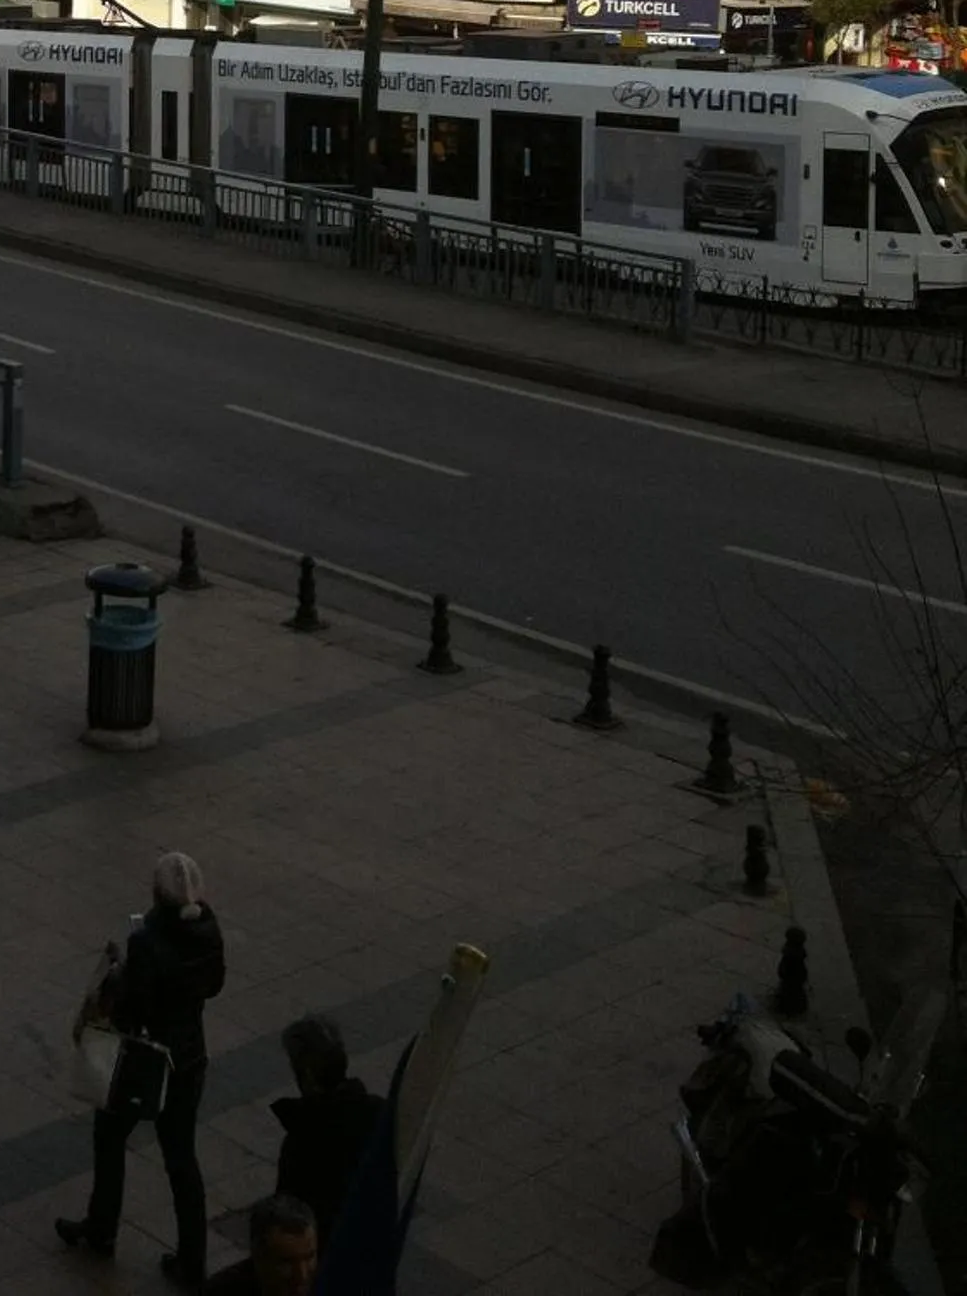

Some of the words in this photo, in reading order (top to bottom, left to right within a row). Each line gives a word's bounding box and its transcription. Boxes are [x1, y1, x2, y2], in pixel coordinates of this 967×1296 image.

[604, 0, 680, 16] TURKCELL
[49, 44, 123, 65] HYUNDAI
[218, 58, 236, 77] Bir
[343, 68, 436, 93] Istbul'dan
[440, 75, 512, 100] Fazlasını
[668, 86, 798, 117] HYUNDAI
[729, 244, 756, 260] SUV
